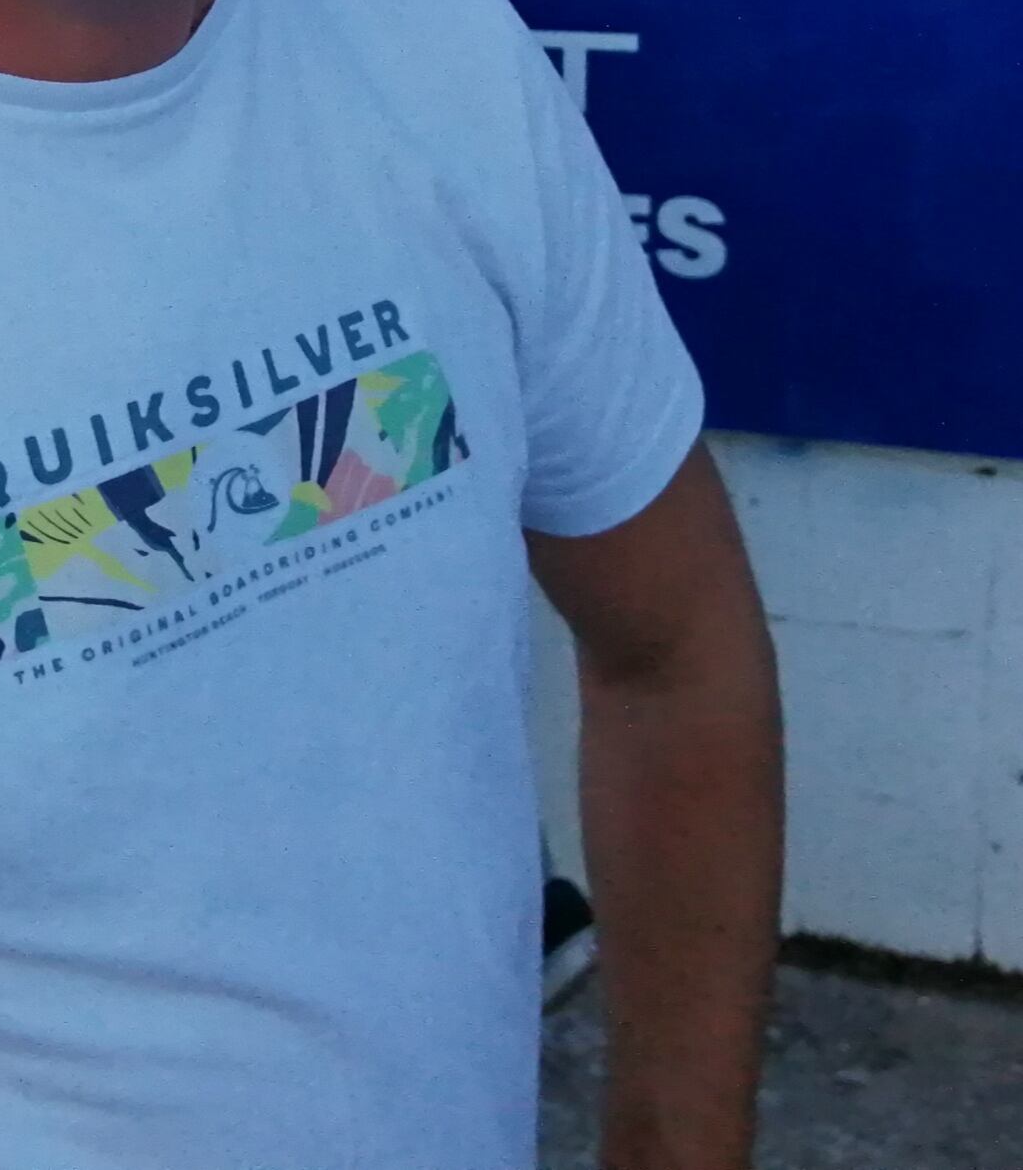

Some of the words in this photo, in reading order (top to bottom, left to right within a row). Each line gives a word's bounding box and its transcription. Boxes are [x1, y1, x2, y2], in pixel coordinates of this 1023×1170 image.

[13, 657, 64, 685] THE
[80, 605, 198, 661] ORIGINAL
[208, 530, 358, 606] BOARDRIDING
